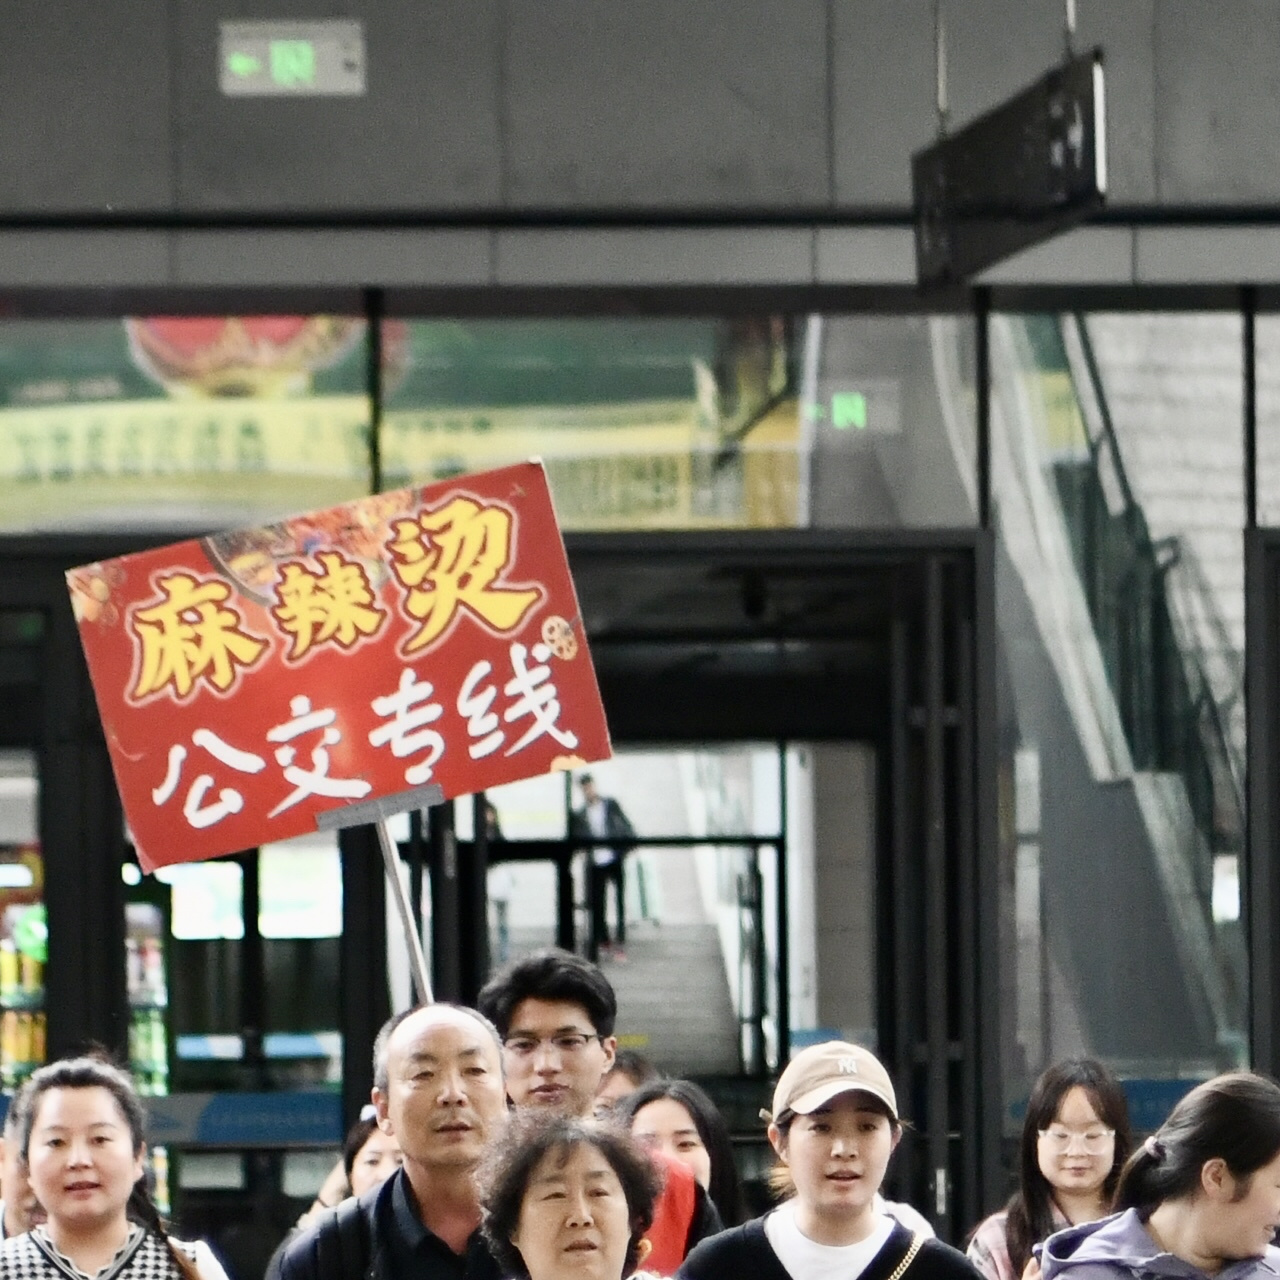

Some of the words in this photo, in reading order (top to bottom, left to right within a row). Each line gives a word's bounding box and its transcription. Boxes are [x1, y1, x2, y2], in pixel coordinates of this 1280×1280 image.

[128, 493, 543, 701] 麻辣烫
[152, 643, 578, 829] 公交专线
